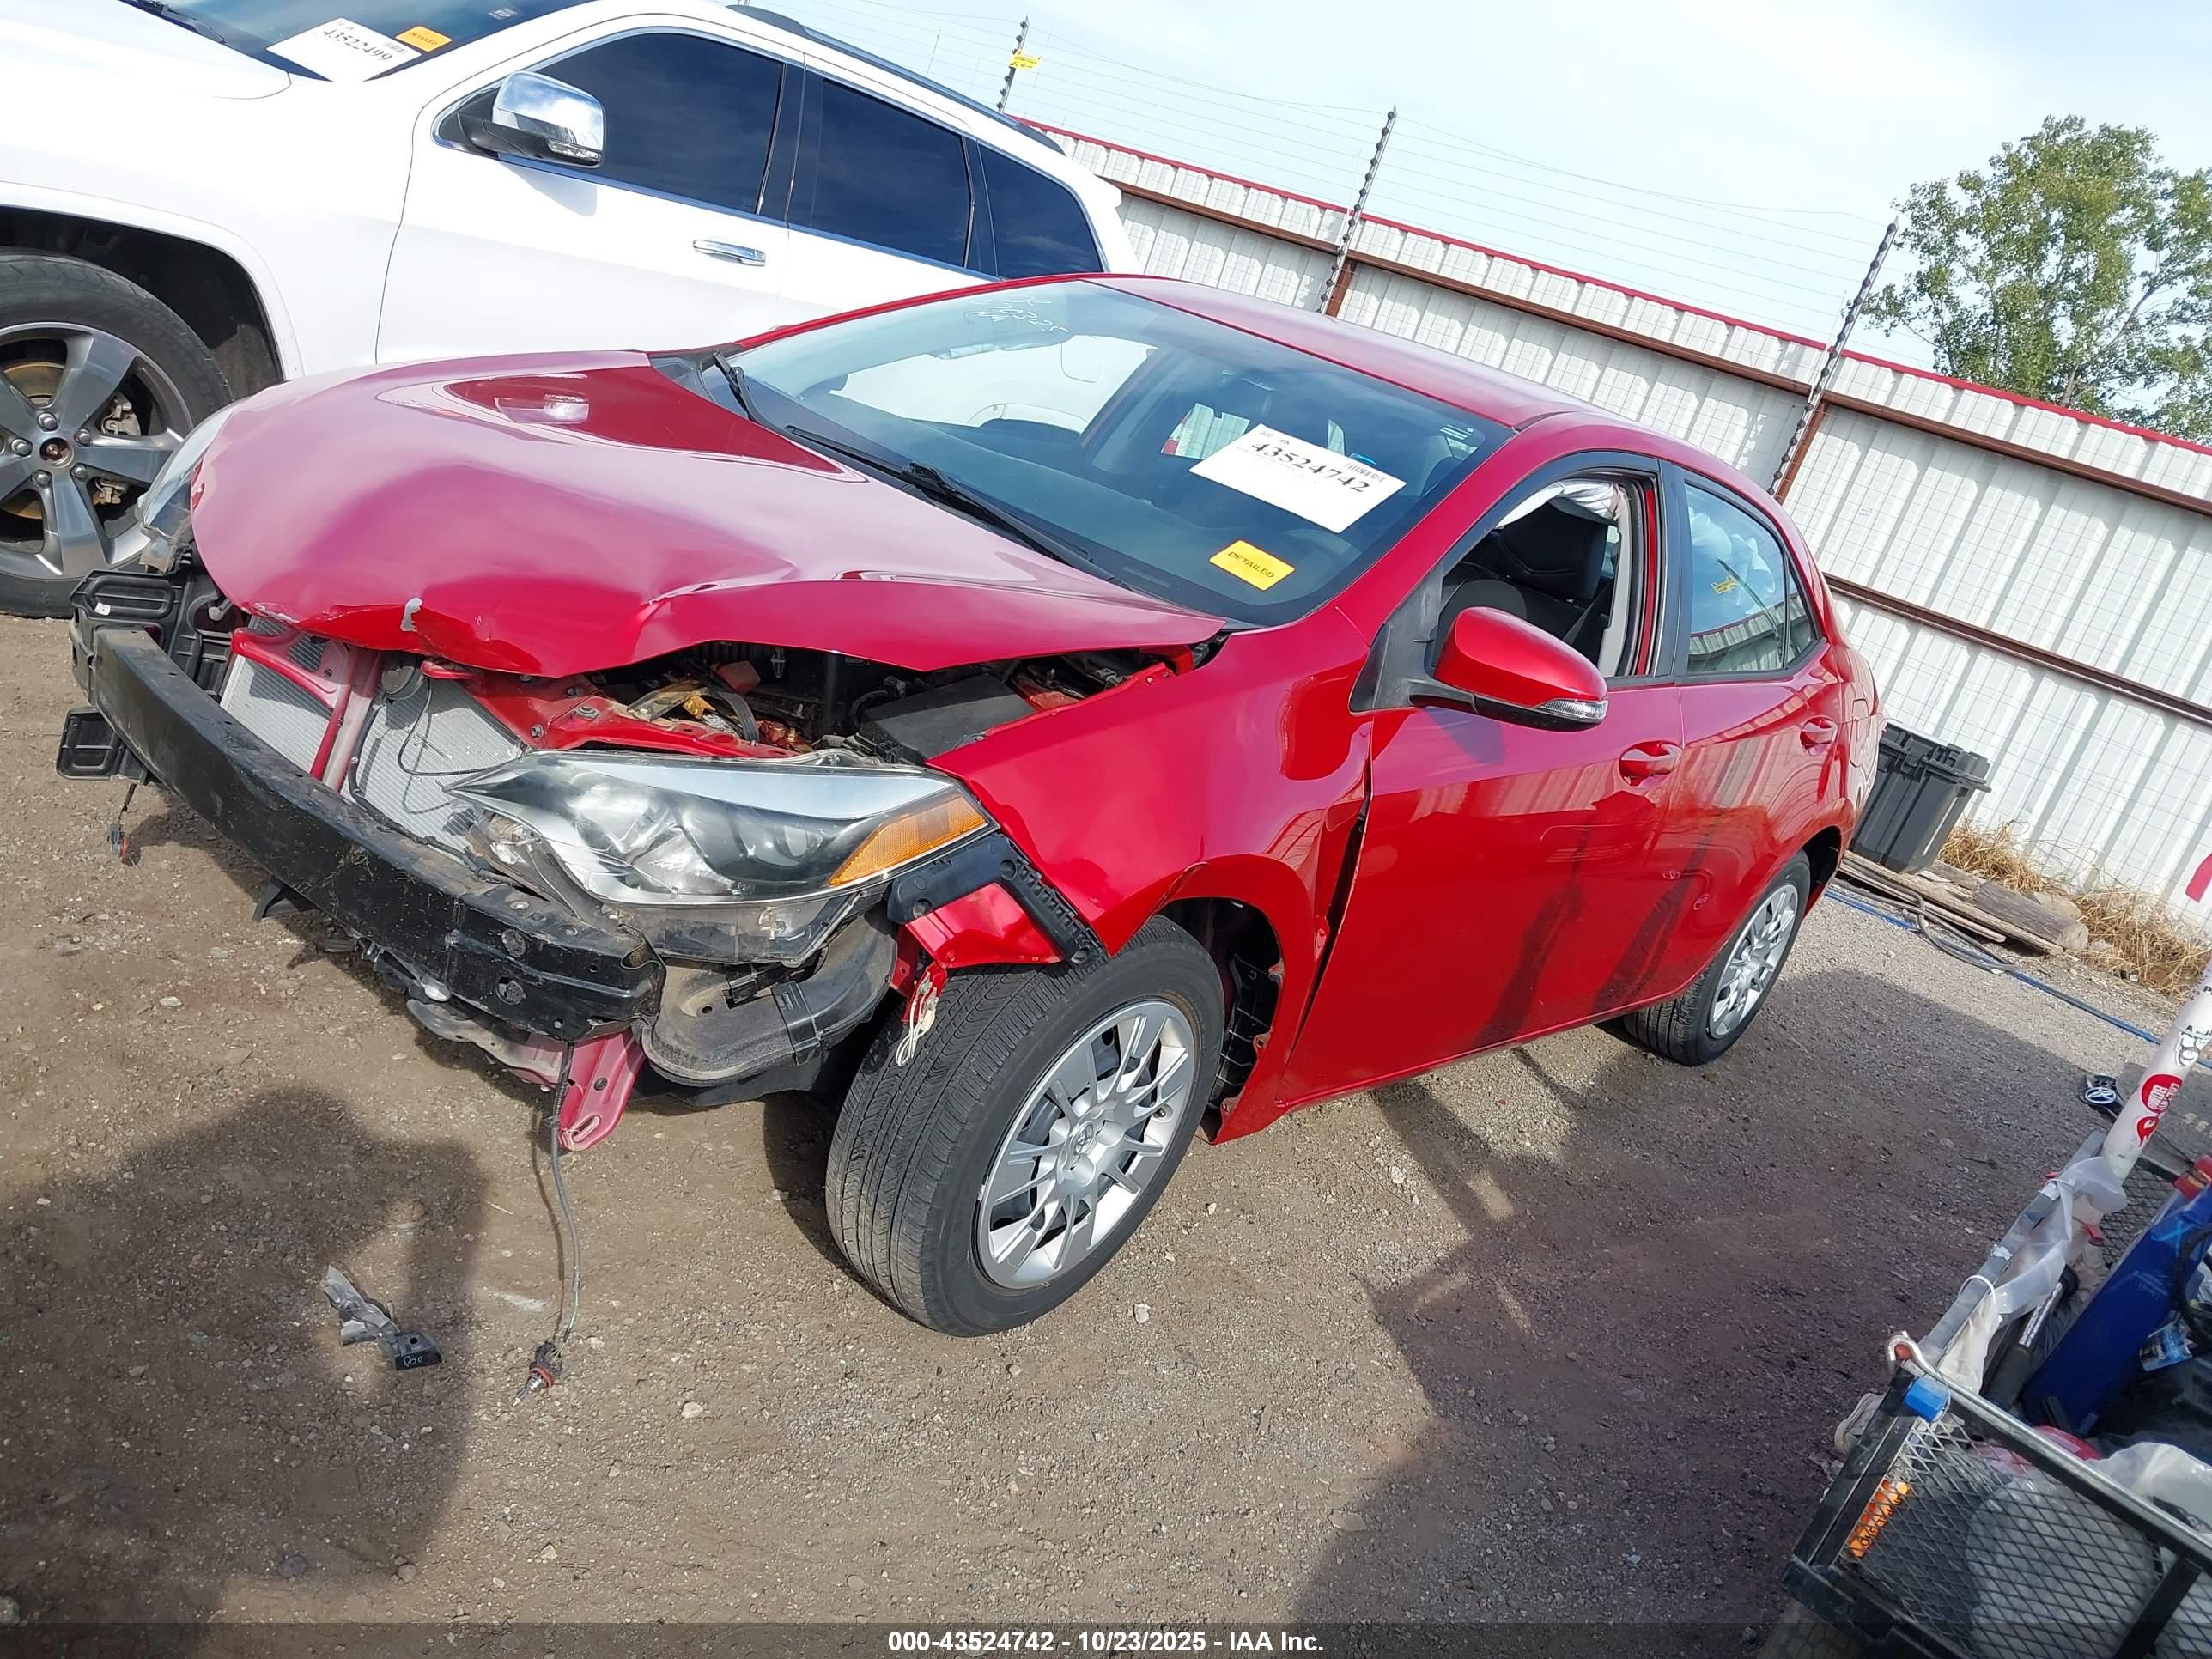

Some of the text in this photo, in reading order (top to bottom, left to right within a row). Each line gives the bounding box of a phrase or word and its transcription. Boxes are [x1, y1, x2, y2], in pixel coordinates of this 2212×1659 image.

[323, 29, 392, 61] 43522499
[1251, 442, 1370, 493] 43524742
[1227, 550, 1275, 579] DETAILED
[2147, 1085, 2168, 1109] BOMB
